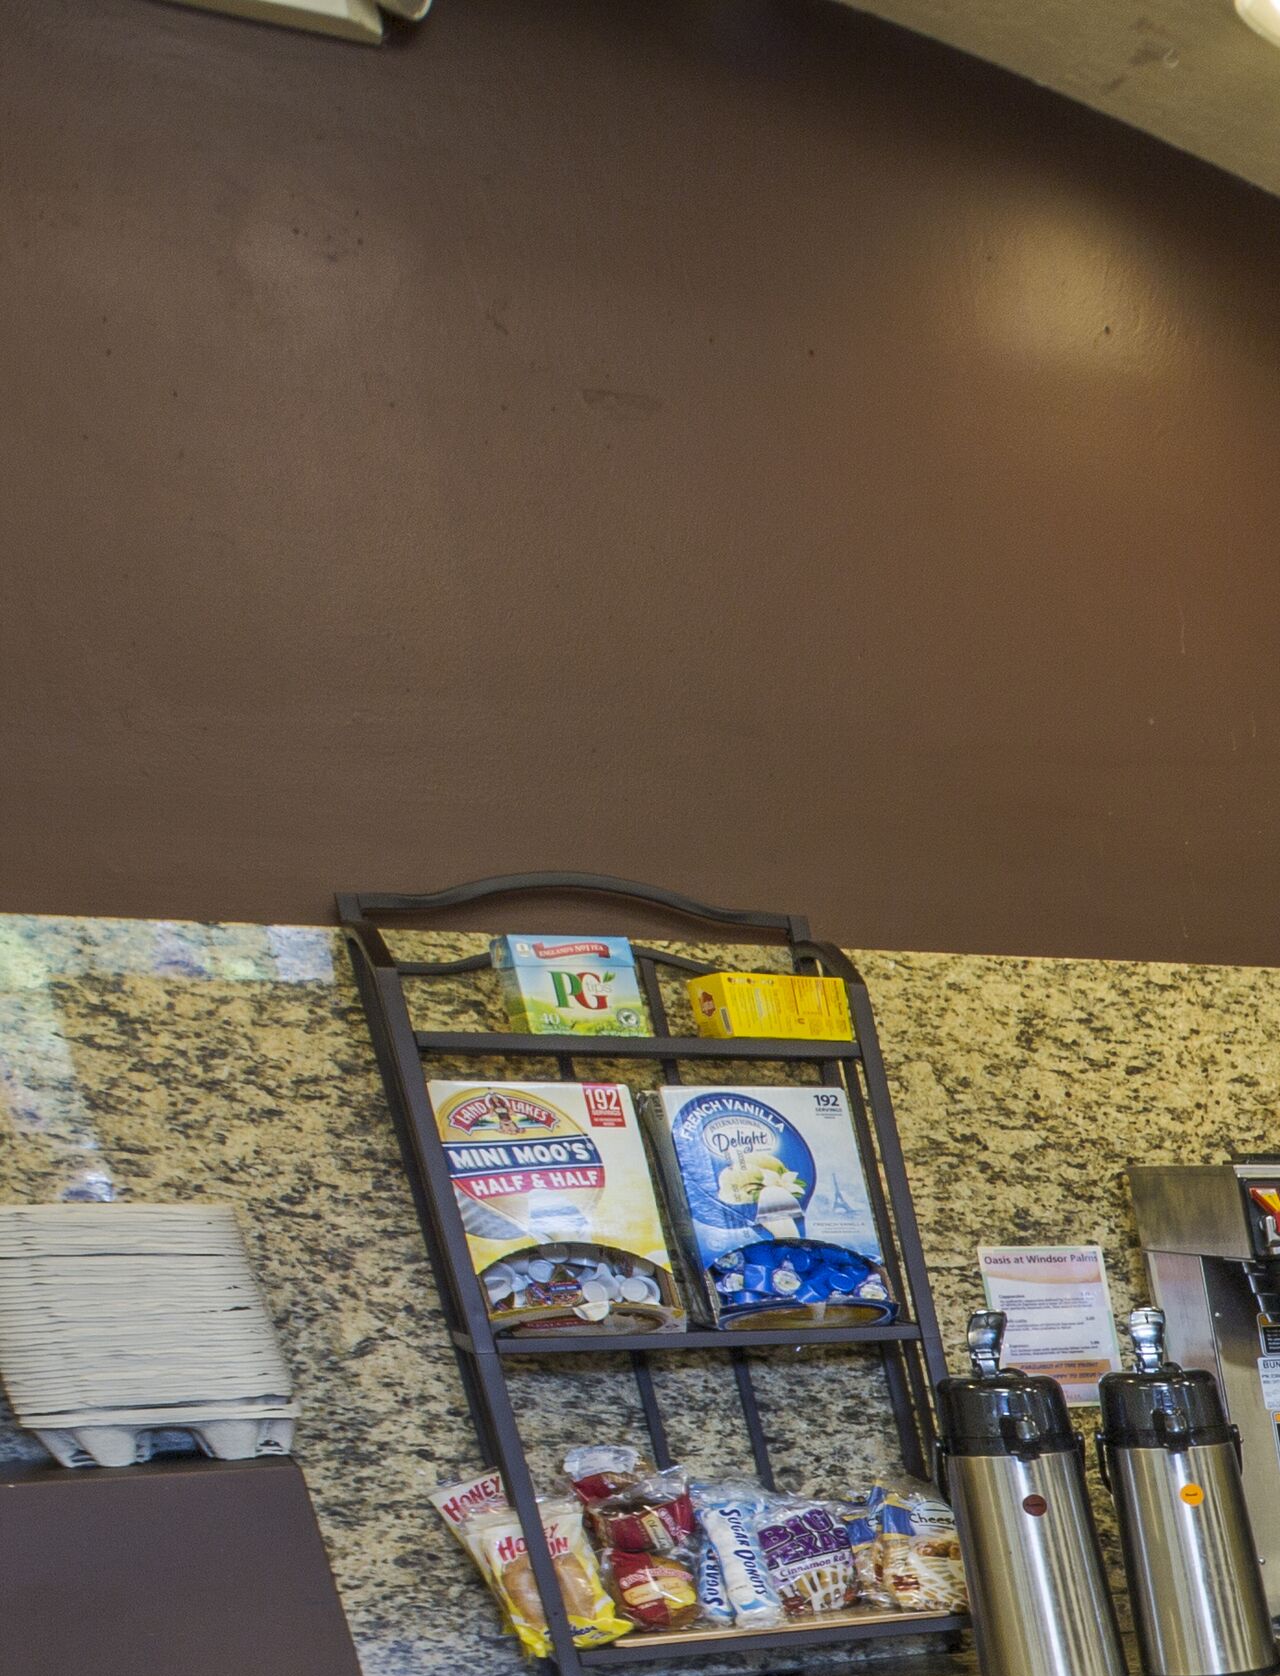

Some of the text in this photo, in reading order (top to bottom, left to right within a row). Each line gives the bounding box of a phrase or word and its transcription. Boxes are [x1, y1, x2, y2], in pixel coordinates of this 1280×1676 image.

[548, 971, 609, 1010] PG
[456, 1102, 487, 1124] LAND
[512, 1099, 549, 1122] LAKES
[585, 1088, 621, 1111] 192
[813, 1094, 841, 1108] 192
[680, 1098, 785, 1141] FRENCH VANILLA
[448, 1141, 590, 1170] MINI MOO'S
[711, 1129, 768, 1154] Delight
[471, 1170, 599, 1197] HALF & HALF
[984, 1253, 1098, 1266] Oasis at Windsor Palms
[442, 1475, 502, 1524] HONEY
[719, 1507, 749, 1546] SUGAR
[757, 1508, 835, 1553] BIG
[765, 1526, 852, 1570] TEXAS
[780, 1560, 832, 1578] Cinnamon
